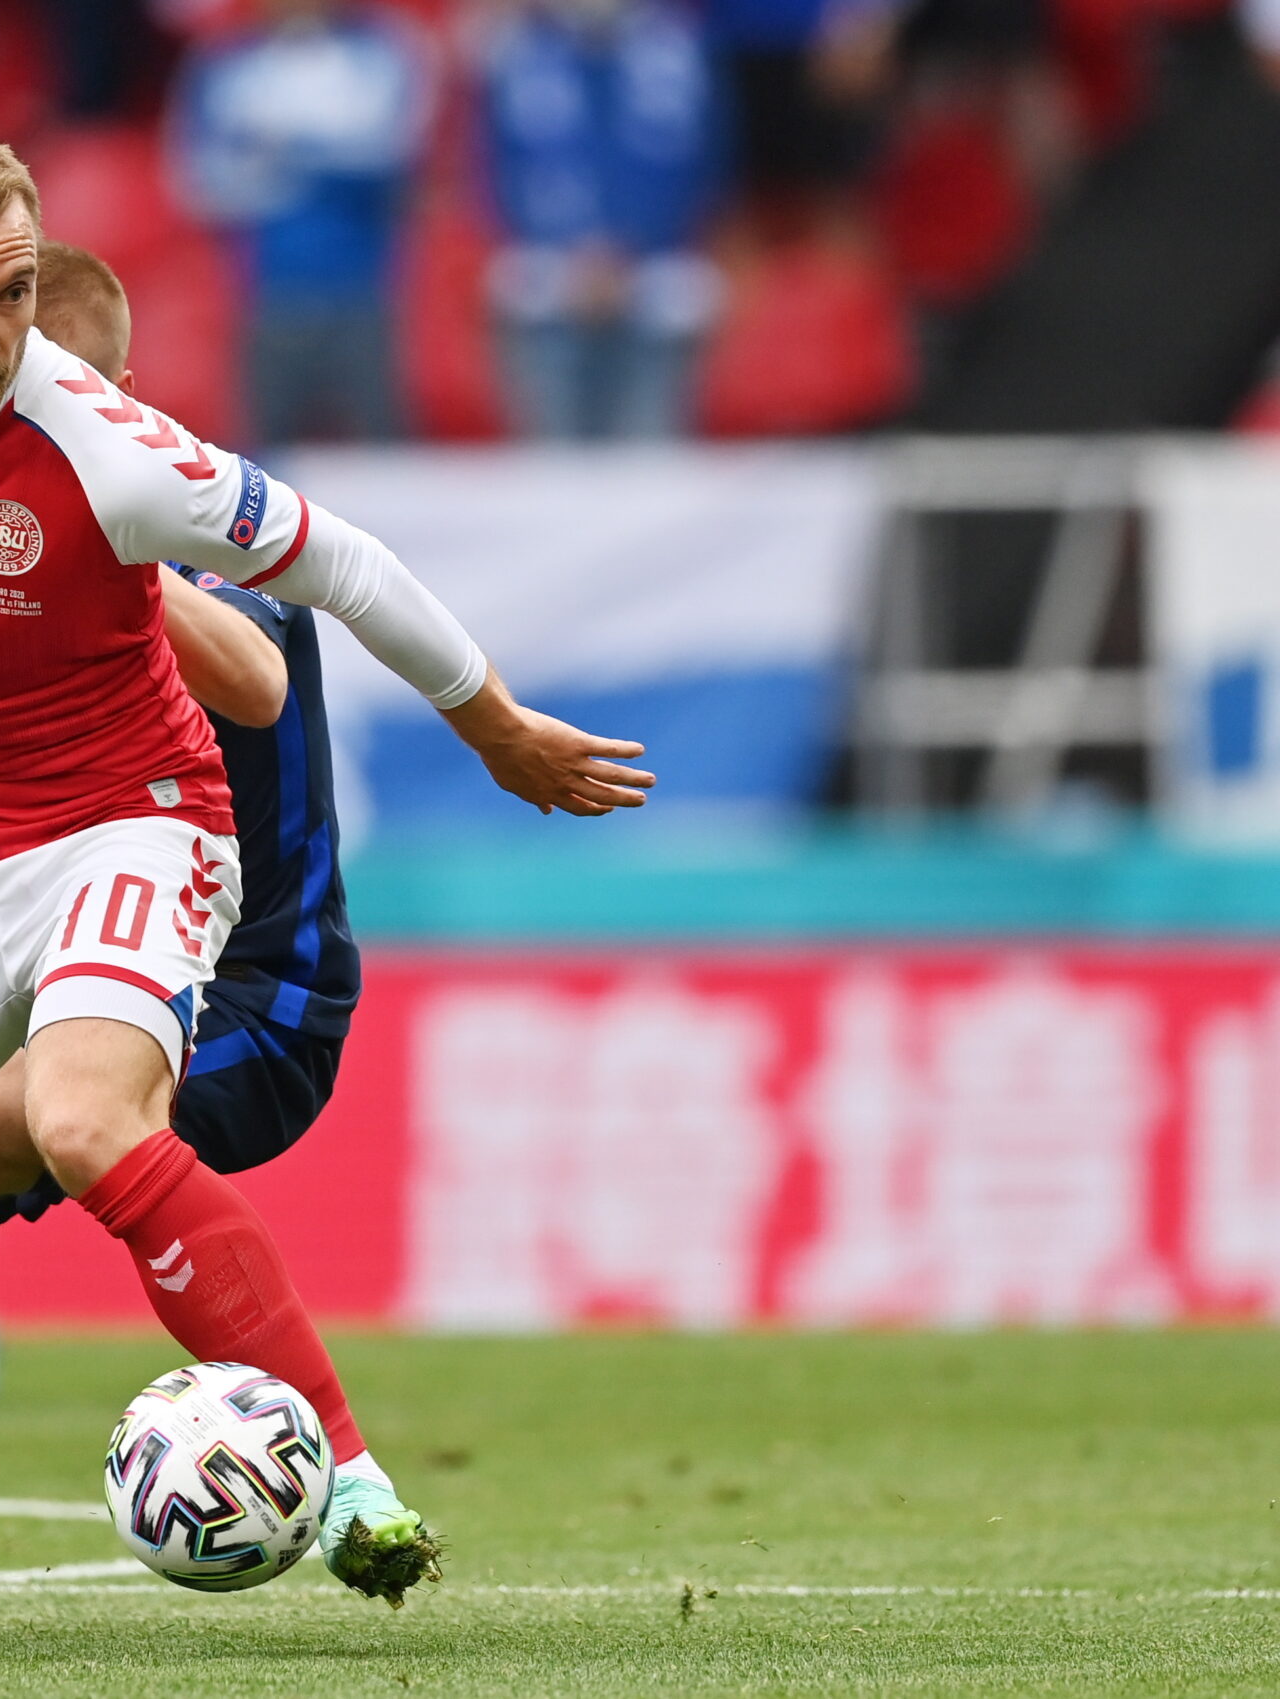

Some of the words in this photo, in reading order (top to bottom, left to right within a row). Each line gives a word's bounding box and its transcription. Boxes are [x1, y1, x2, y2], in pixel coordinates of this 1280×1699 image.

[21, 530, 40, 567] UNION
[10, 589, 25, 600] 2020
[14, 600, 41, 609] FINLAND
[60, 872, 156, 952] 10
